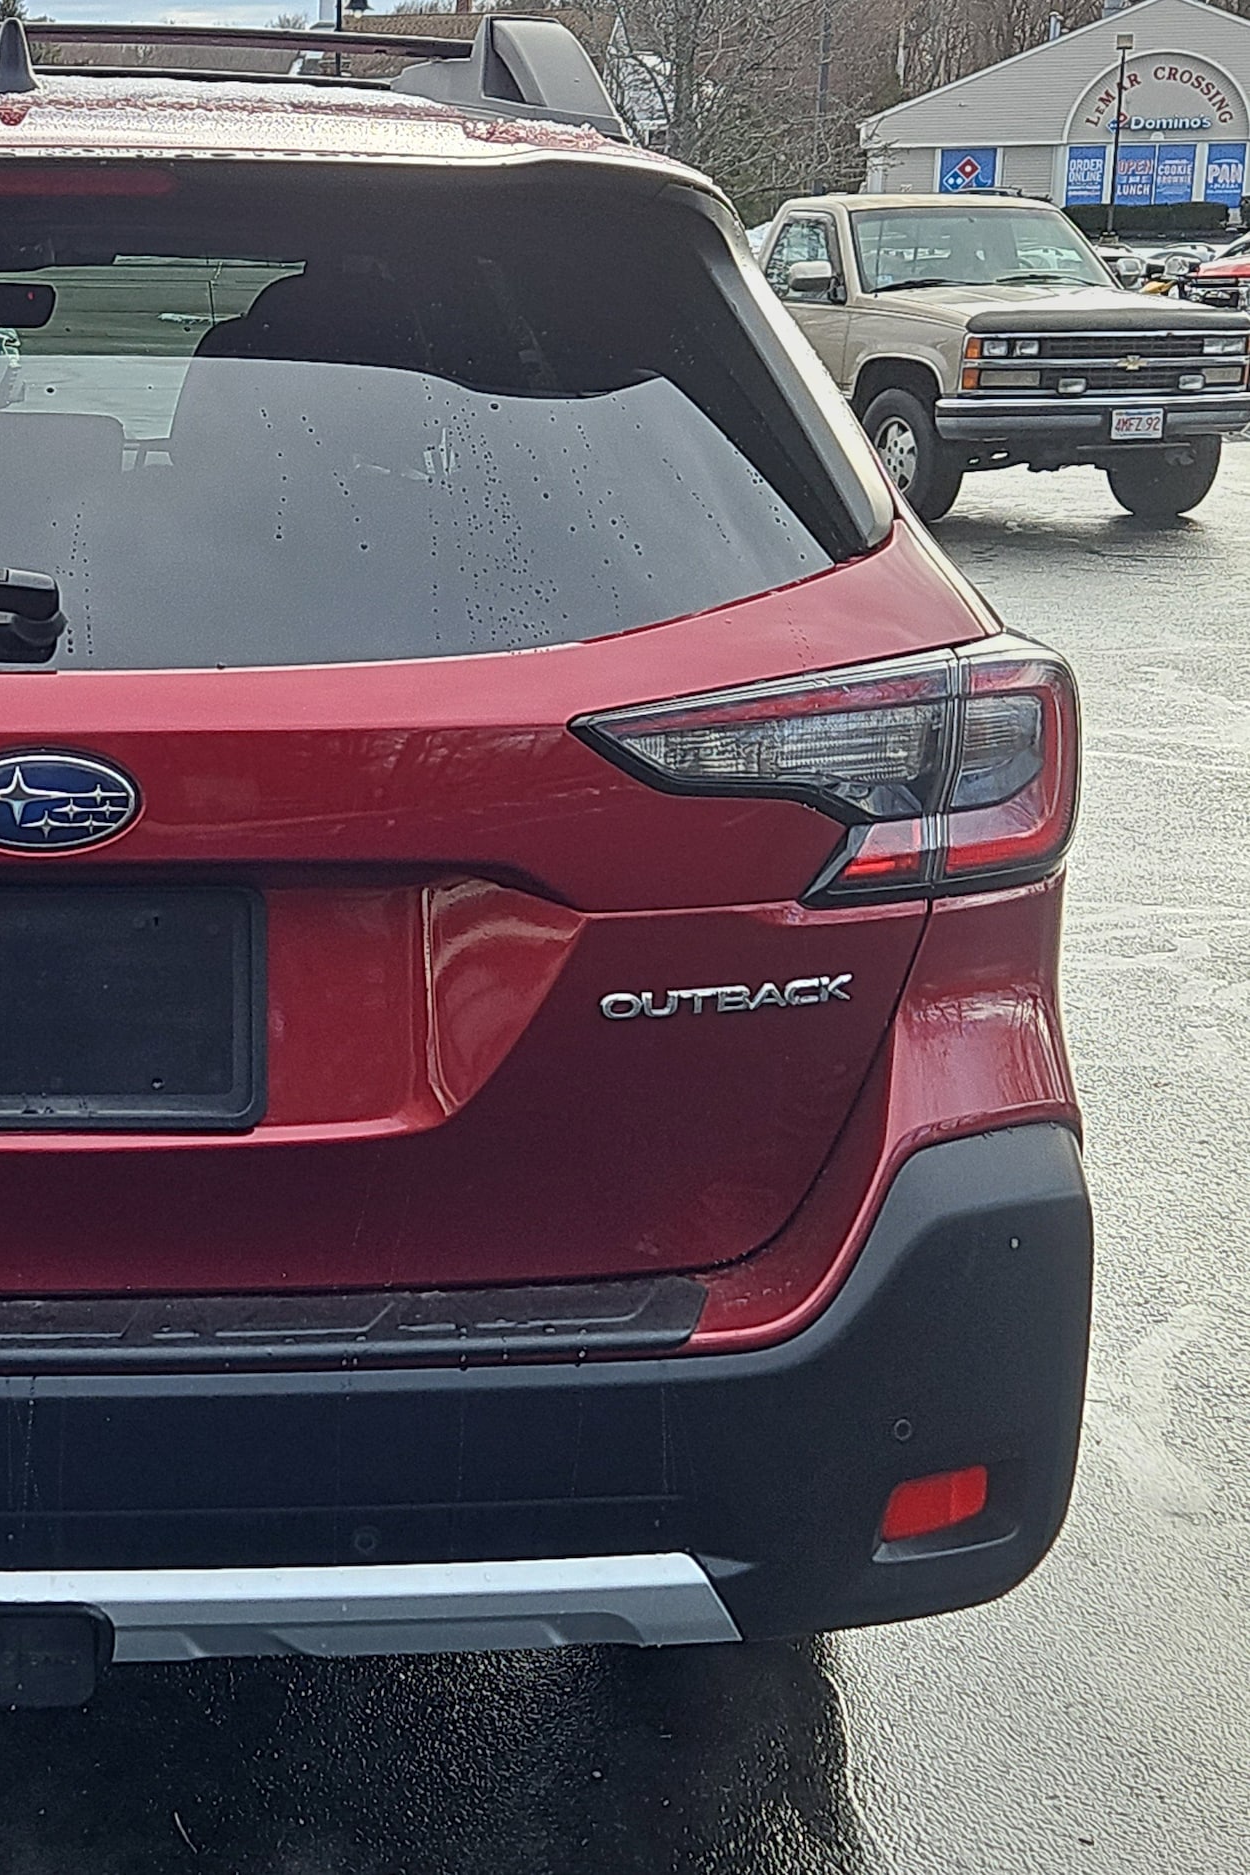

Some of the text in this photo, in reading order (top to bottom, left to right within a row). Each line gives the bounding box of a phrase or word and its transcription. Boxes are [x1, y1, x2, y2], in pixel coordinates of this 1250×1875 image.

[1153, 65, 1234, 124] CROSSING
[1130, 114, 1212, 131] Domino's
[1070, 159, 1104, 171] ORDER
[1117, 159, 1154, 175] OPEN
[1157, 164, 1194, 176] COOKIE
[1069, 170, 1103, 183] ONLINE
[1207, 164, 1244, 184] PAN
[1116, 184, 1151, 196] LUNCH
[600, 973, 853, 1020] OUTBACK
